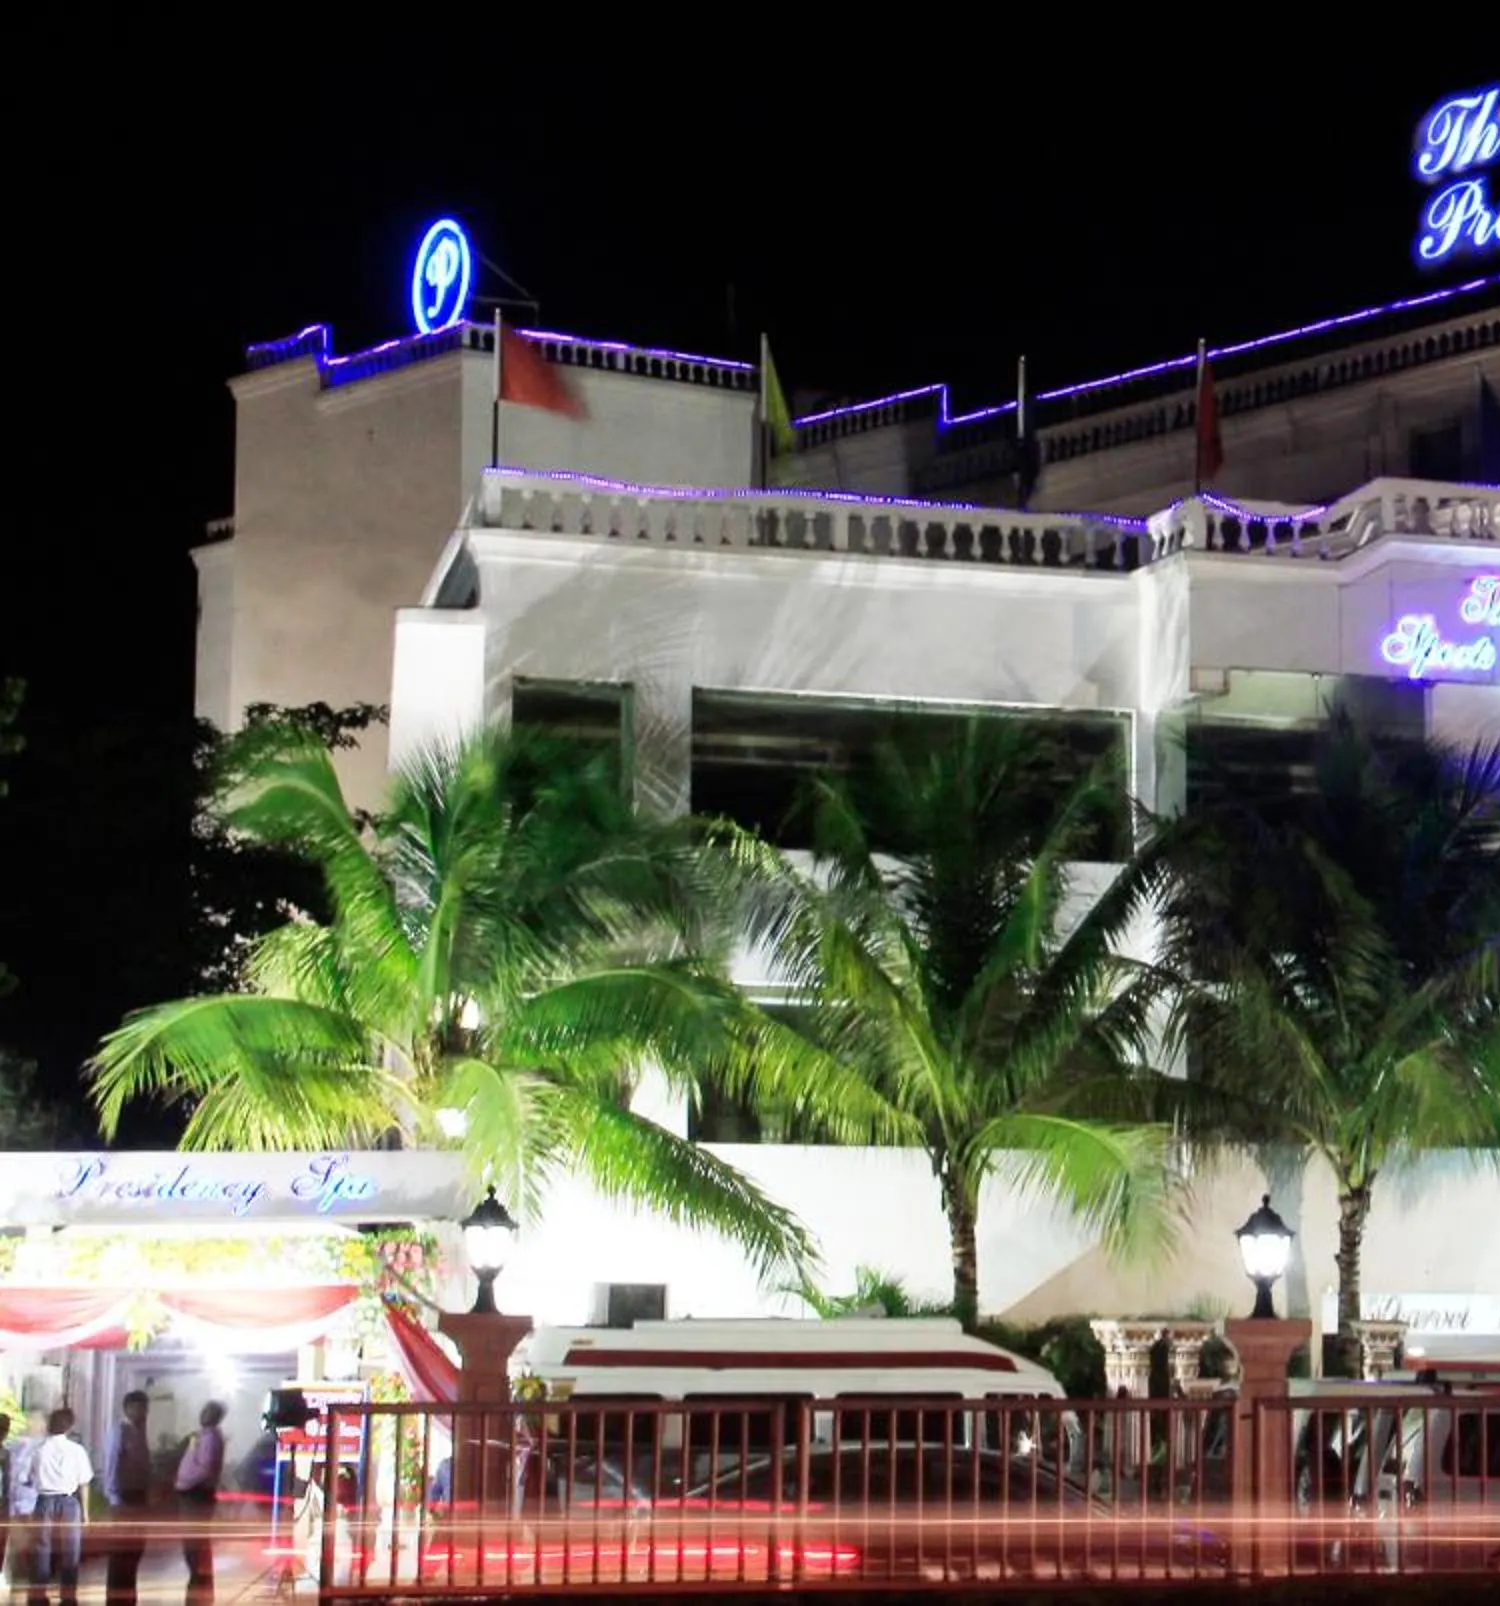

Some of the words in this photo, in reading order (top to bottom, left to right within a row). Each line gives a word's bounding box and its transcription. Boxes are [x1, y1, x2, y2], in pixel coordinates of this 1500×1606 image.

[1381, 614, 1497, 680] Sports
[54, 1152, 270, 1215] Presidency
[290, 1152, 378, 1214] Spa
